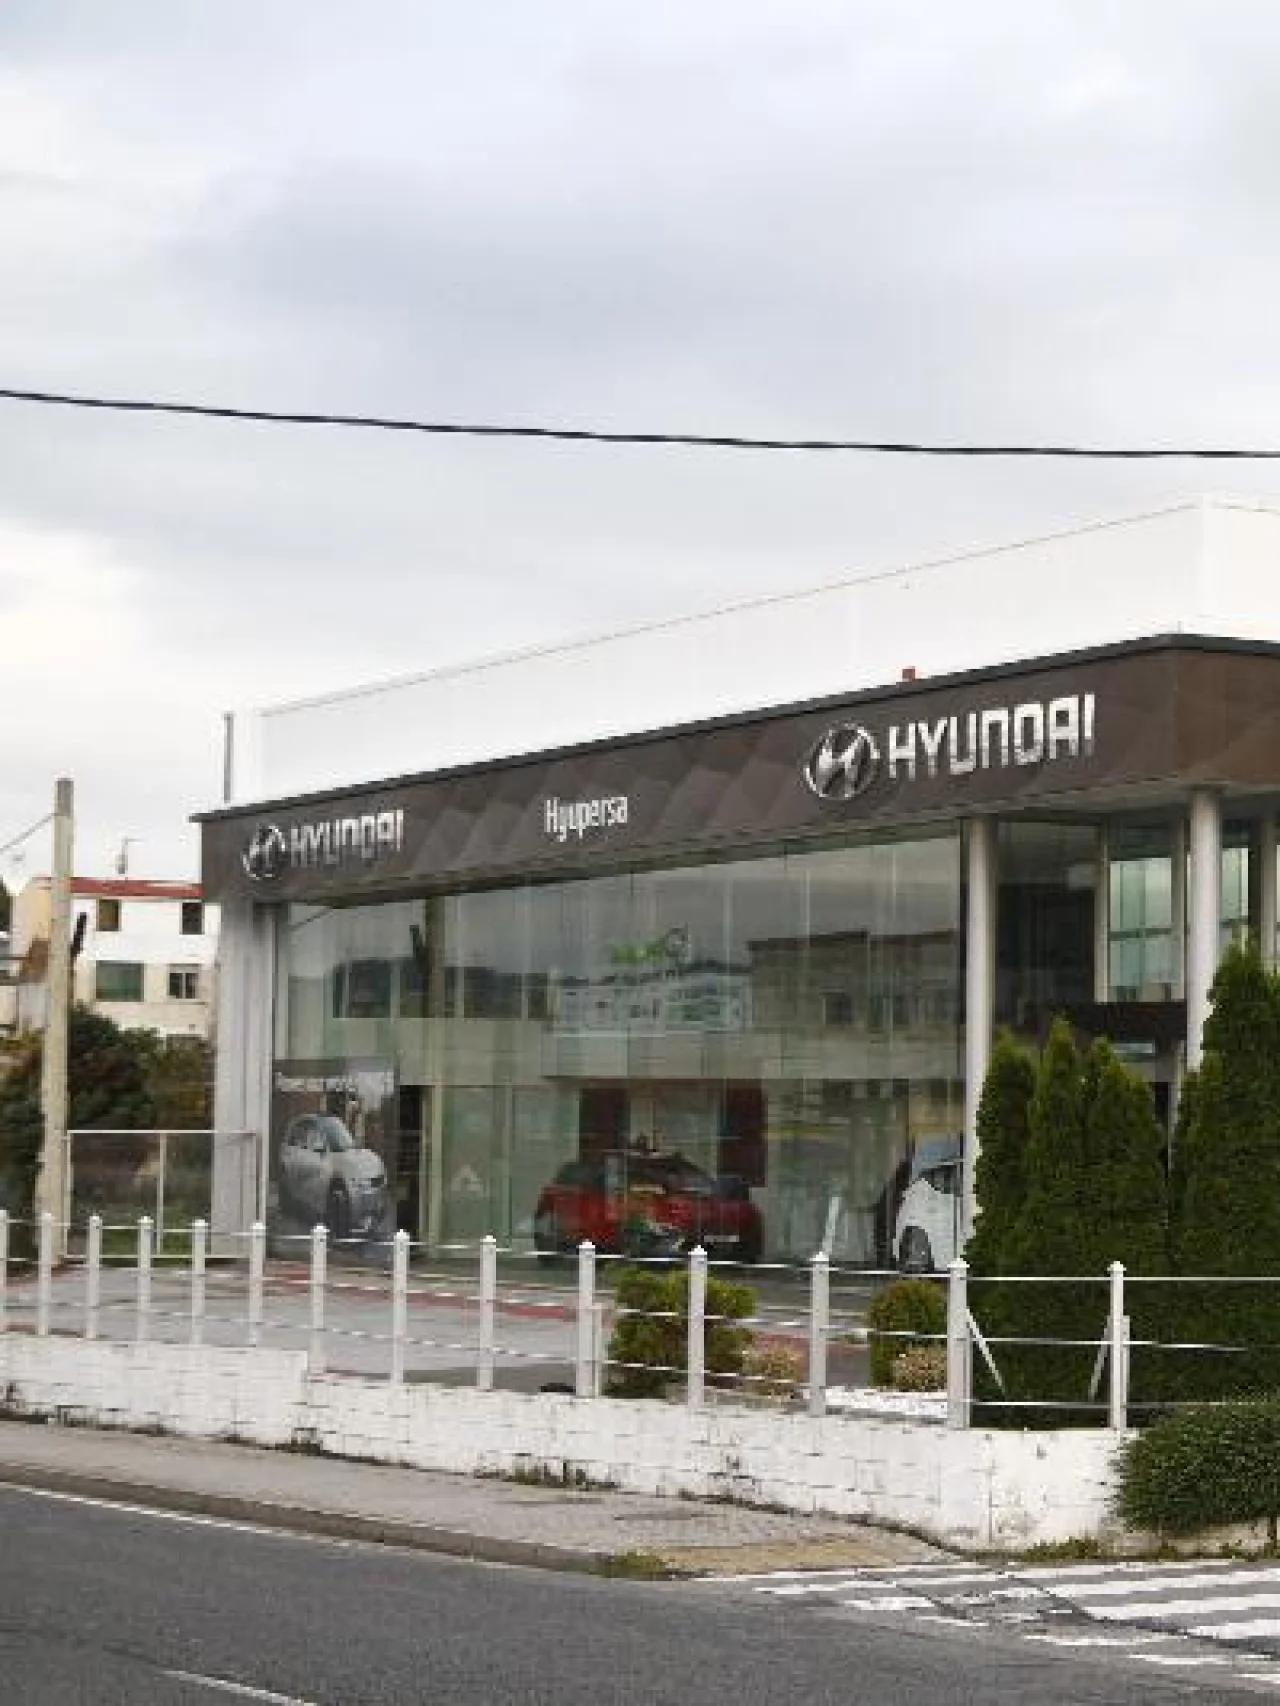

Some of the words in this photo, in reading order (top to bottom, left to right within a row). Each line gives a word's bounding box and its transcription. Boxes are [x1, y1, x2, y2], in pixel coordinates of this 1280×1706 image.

[888, 692, 1095, 779] HYUNDAI
[290, 809, 404, 869] HYUNDAI
[544, 796, 628, 843] Hyupersa
